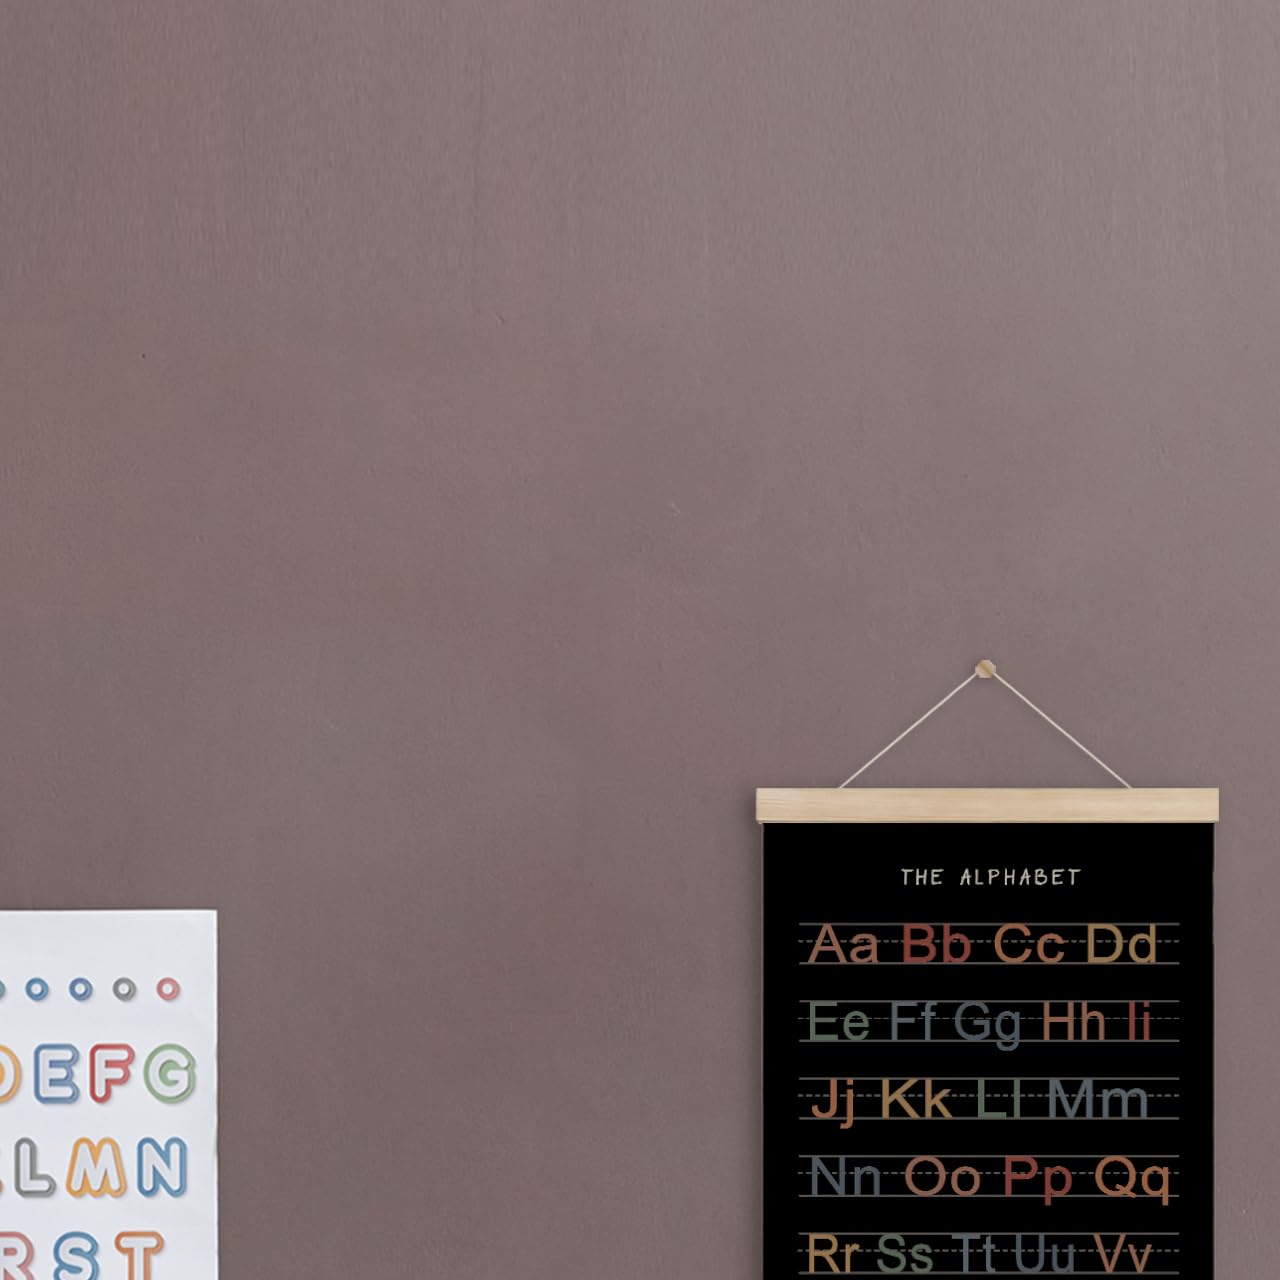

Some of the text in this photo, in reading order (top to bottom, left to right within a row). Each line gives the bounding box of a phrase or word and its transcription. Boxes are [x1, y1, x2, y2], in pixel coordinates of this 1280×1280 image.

[900, 867, 1082, 886] THE ALPHABET
[807, 923, 1156, 963] Aa Bb Cc Dd
[807, 1001, 1151, 1051] Ee Ff Gg Hh Ii
[810, 1078, 1148, 1129] Jj Kk Ll Mm
[810, 1155, 1169, 1205] Nn Oo Pp Qq
[808, 1233, 1152, 1273] Rr Ss Tt Uu Vv
